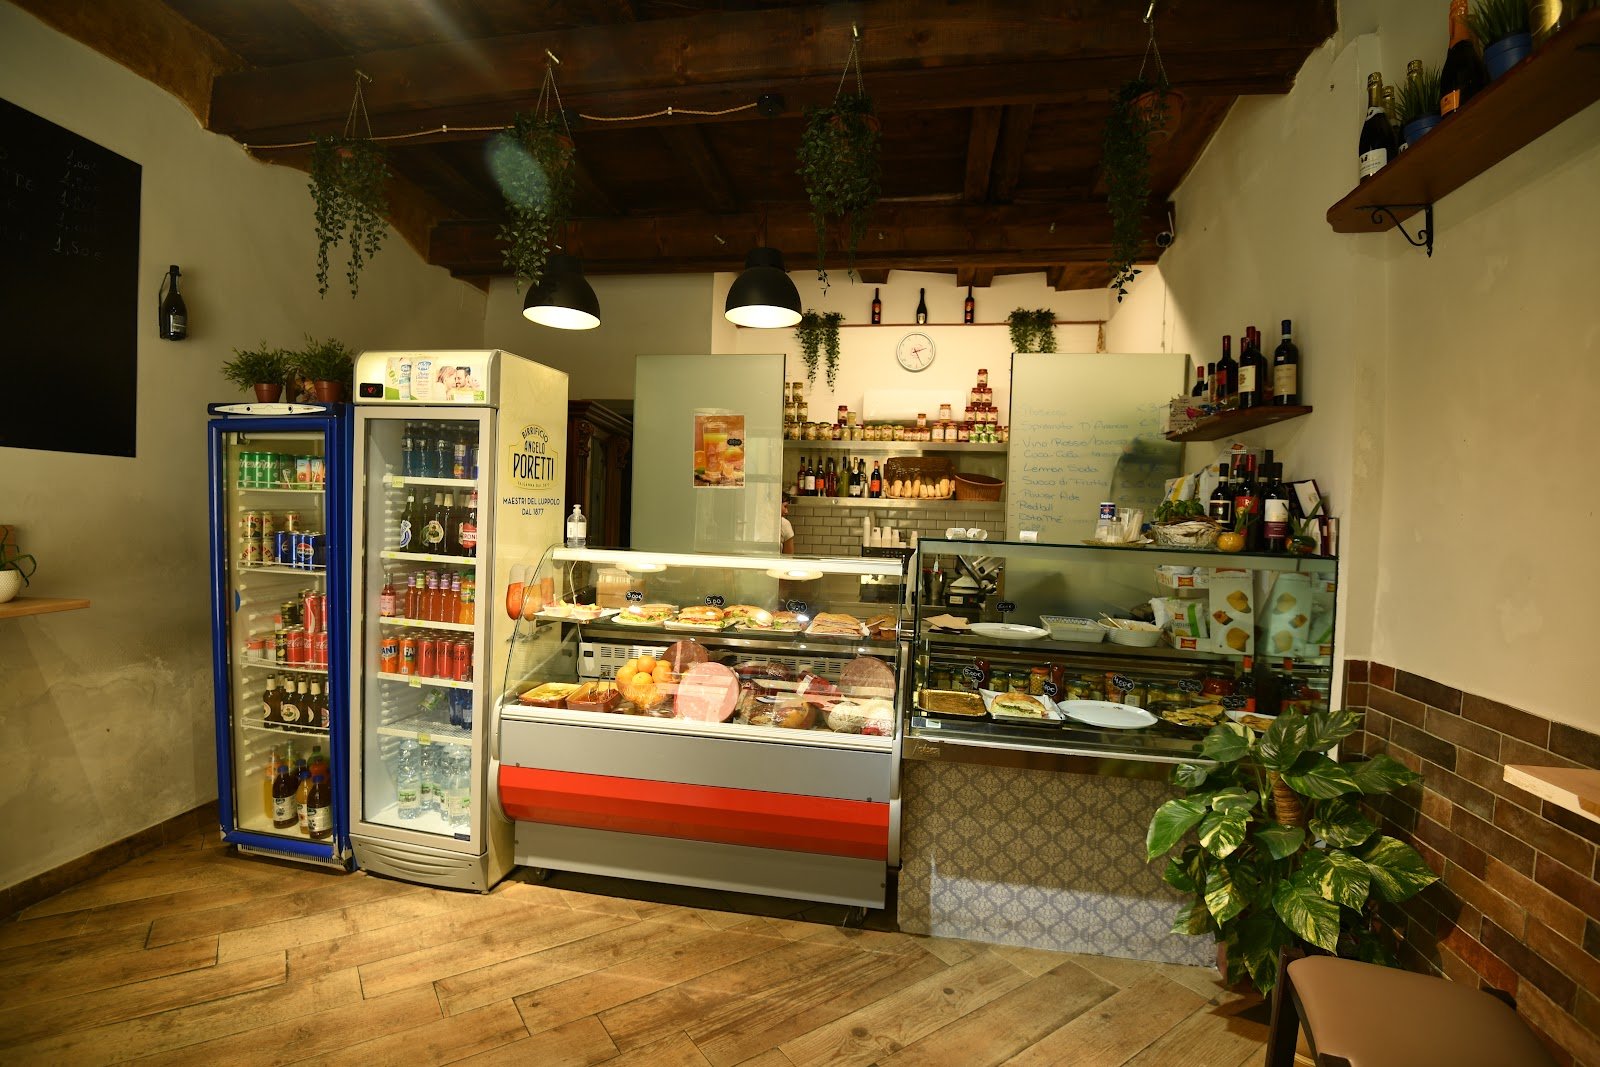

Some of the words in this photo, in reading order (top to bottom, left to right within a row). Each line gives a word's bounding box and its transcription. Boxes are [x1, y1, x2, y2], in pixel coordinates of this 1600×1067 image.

[521, 426, 549, 443] BIRRIFICIO
[524, 440, 546, 455] ANGELO
[1022, 436, 1048, 449] Vino
[513, 453, 555, 481] PORETTI
[1023, 463, 1064, 473] Lemon
[1067, 463, 1099, 473] Soda
[1021, 476, 1057, 487] Succo
[502, 497, 527, 505] MAESTRI
[538, 498, 561, 506] LUPPOLO
[521, 508, 532, 516] DAL
[533, 508, 545, 516] 1877
